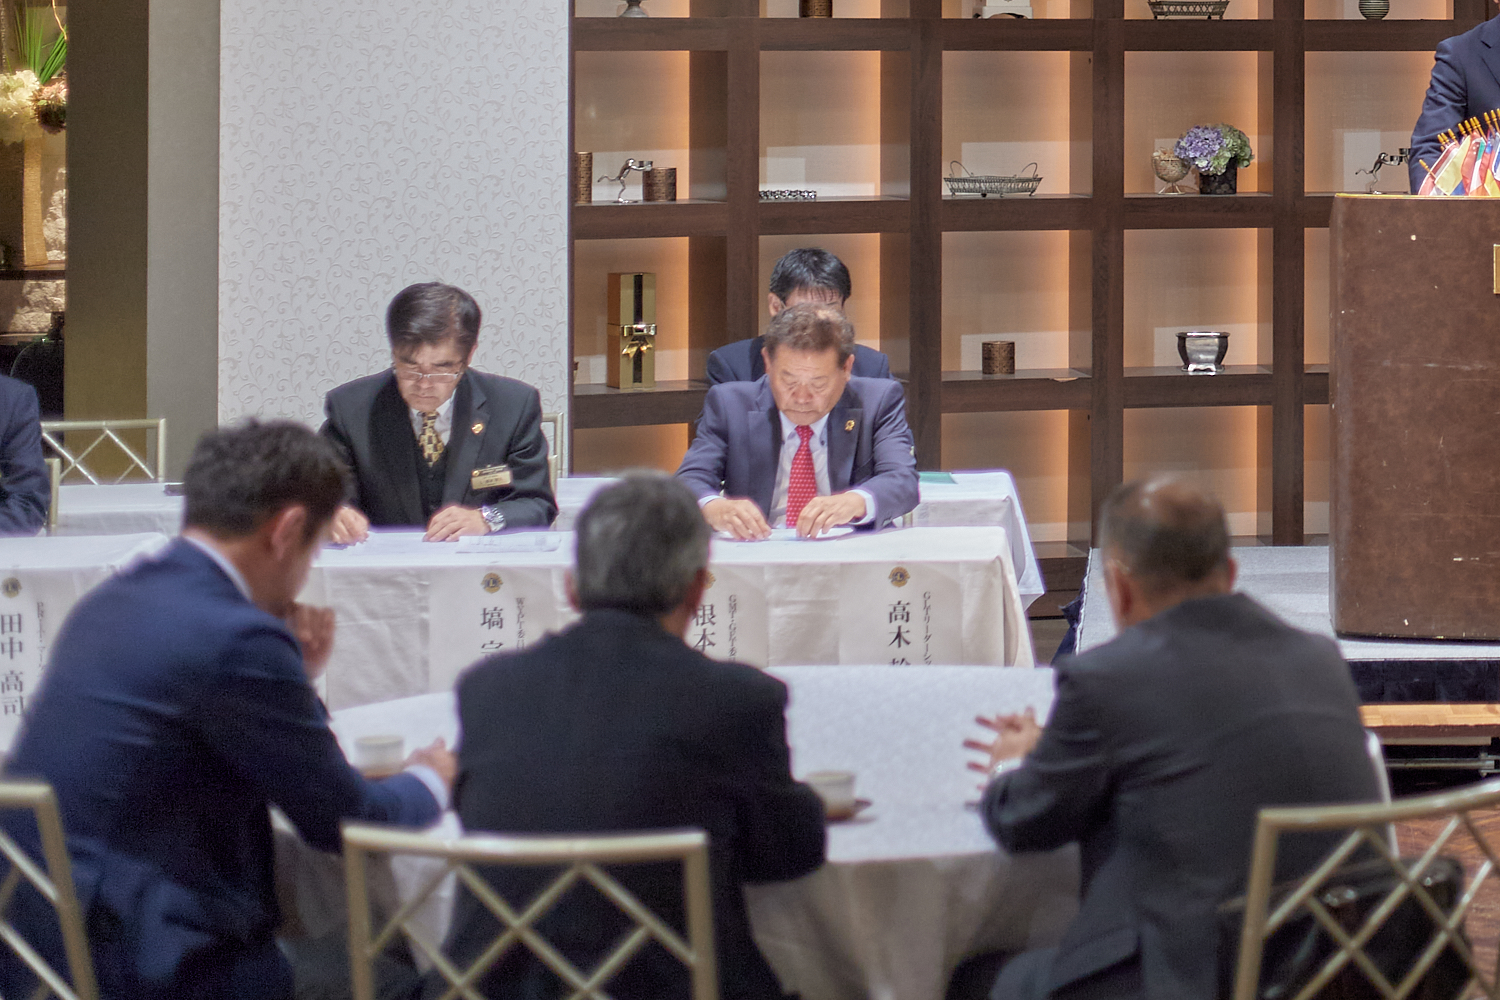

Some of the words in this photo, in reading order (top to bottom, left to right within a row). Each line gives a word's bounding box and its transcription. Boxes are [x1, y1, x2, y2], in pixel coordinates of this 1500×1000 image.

[0, 613, 23, 660] 田中
[694, 604, 716, 653] 根本
[888, 600, 911, 648] 高木
